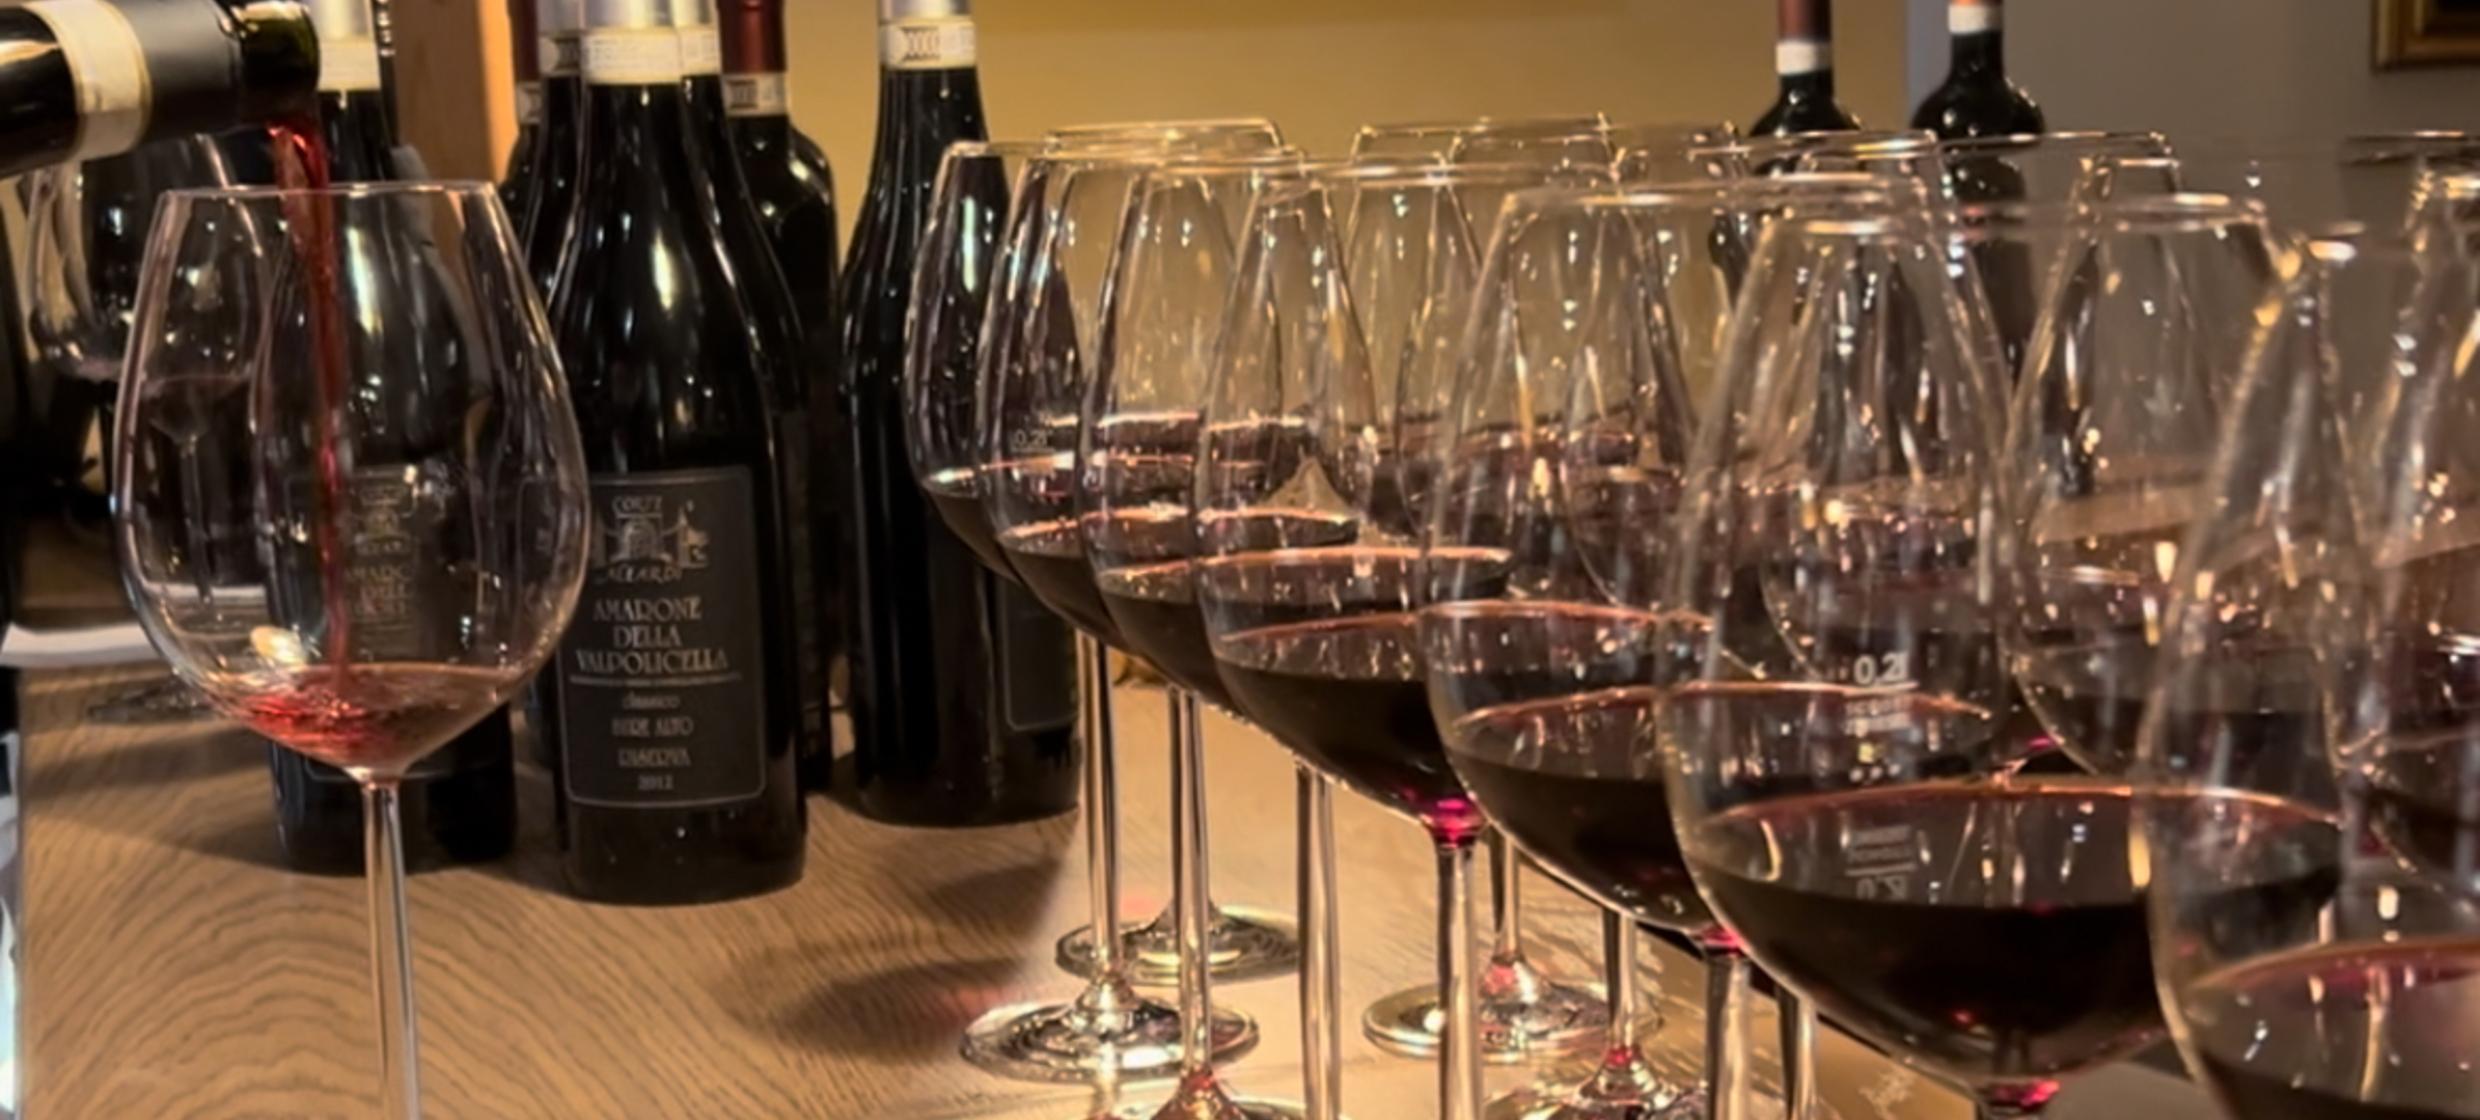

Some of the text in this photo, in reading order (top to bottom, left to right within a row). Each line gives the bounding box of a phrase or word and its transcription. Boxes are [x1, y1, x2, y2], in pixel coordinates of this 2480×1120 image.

[593, 595, 703, 621] AMARONE
[613, 624, 683, 648] DELLA
[575, 648, 729, 674] VALPOLICELLA
